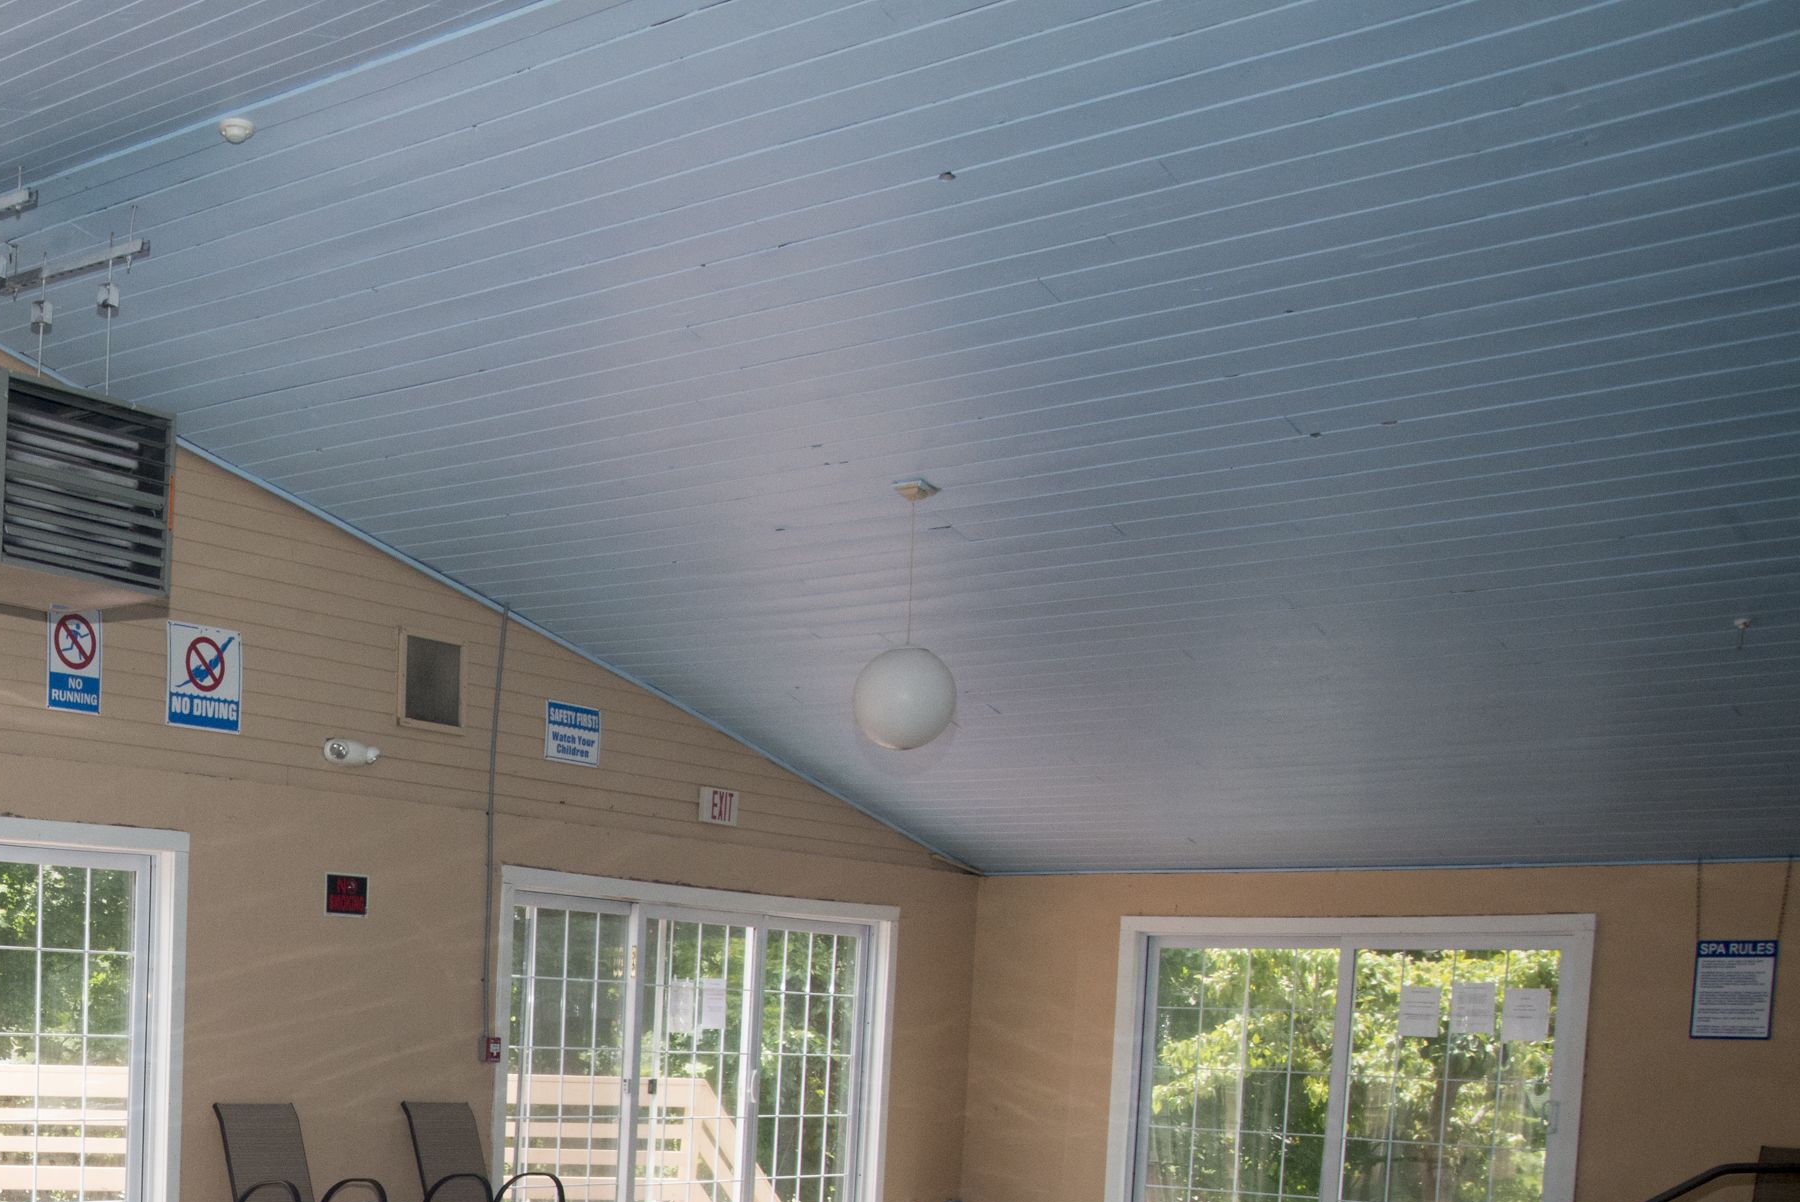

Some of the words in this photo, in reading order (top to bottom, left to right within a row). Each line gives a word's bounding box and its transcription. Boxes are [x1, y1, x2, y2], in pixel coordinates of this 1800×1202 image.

[68, 676, 83, 690] NO
[51, 688, 98, 706] RUNNING
[171, 695, 191, 715] NO
[193, 698, 237, 721] DIVING
[550, 706, 576, 726] SAFETY
[552, 730, 576, 745] Watch
[578, 735, 596, 748] Your
[557, 743, 589, 758] Children
[711, 790, 734, 822] EXIT
[1700, 943, 1726, 955] SPA
[1729, 943, 1776, 955] RULES
